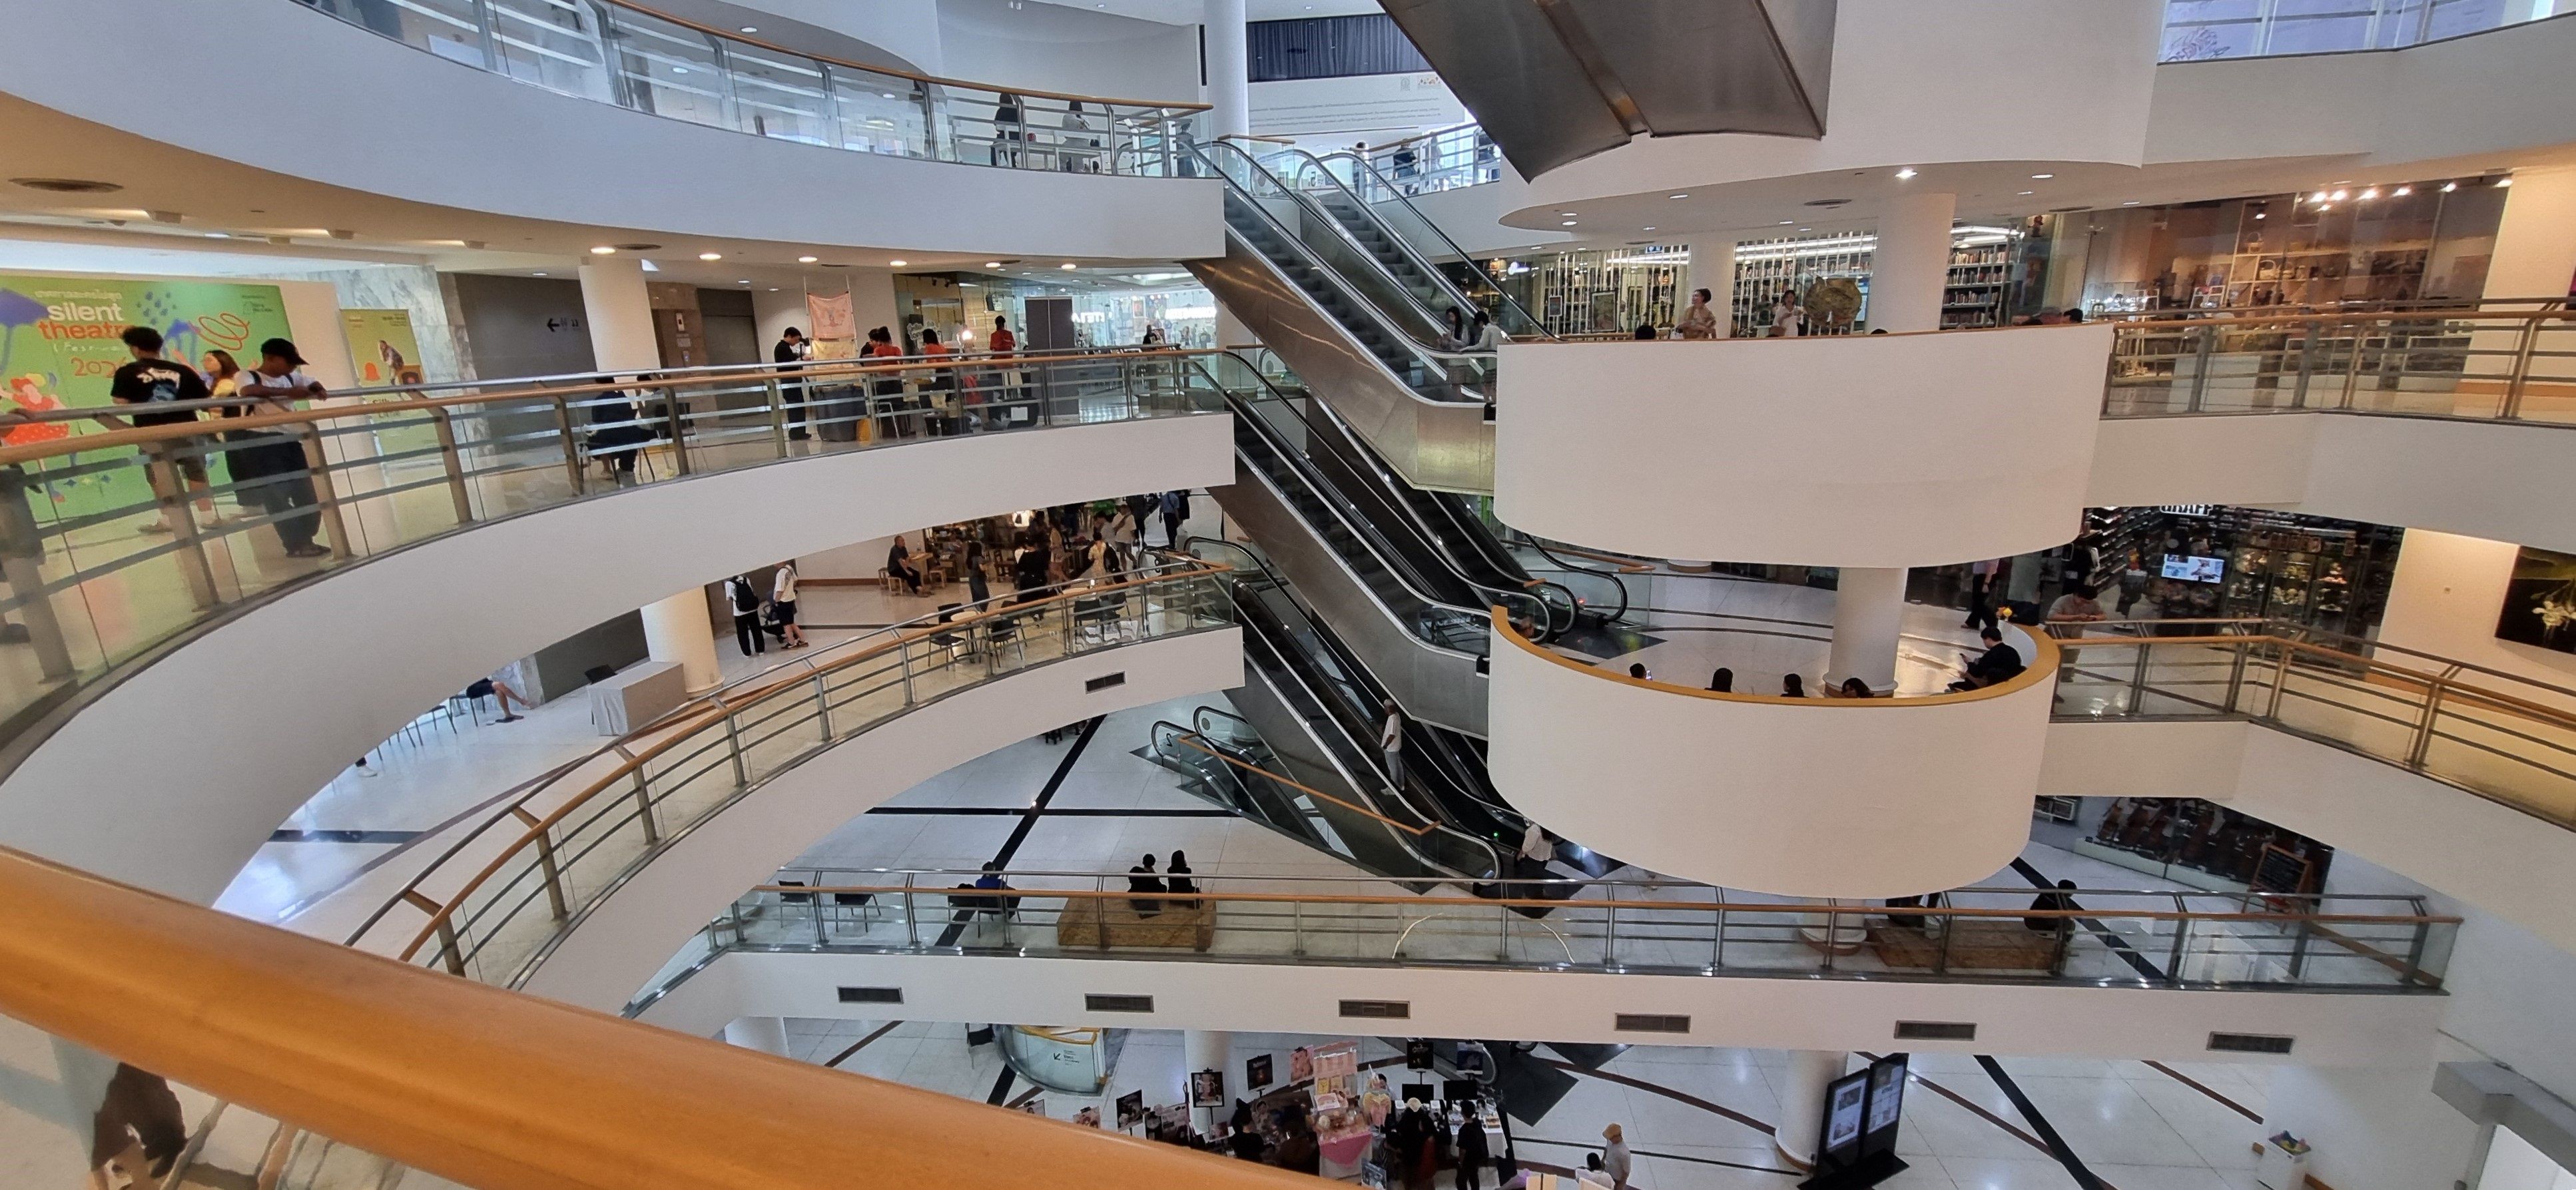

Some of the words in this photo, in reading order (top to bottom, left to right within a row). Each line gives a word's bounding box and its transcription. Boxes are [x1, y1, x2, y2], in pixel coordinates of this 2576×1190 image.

[47, 302, 125, 321] silent
[38, 320, 133, 340] theatr
[71, 357, 127, 378] 202
